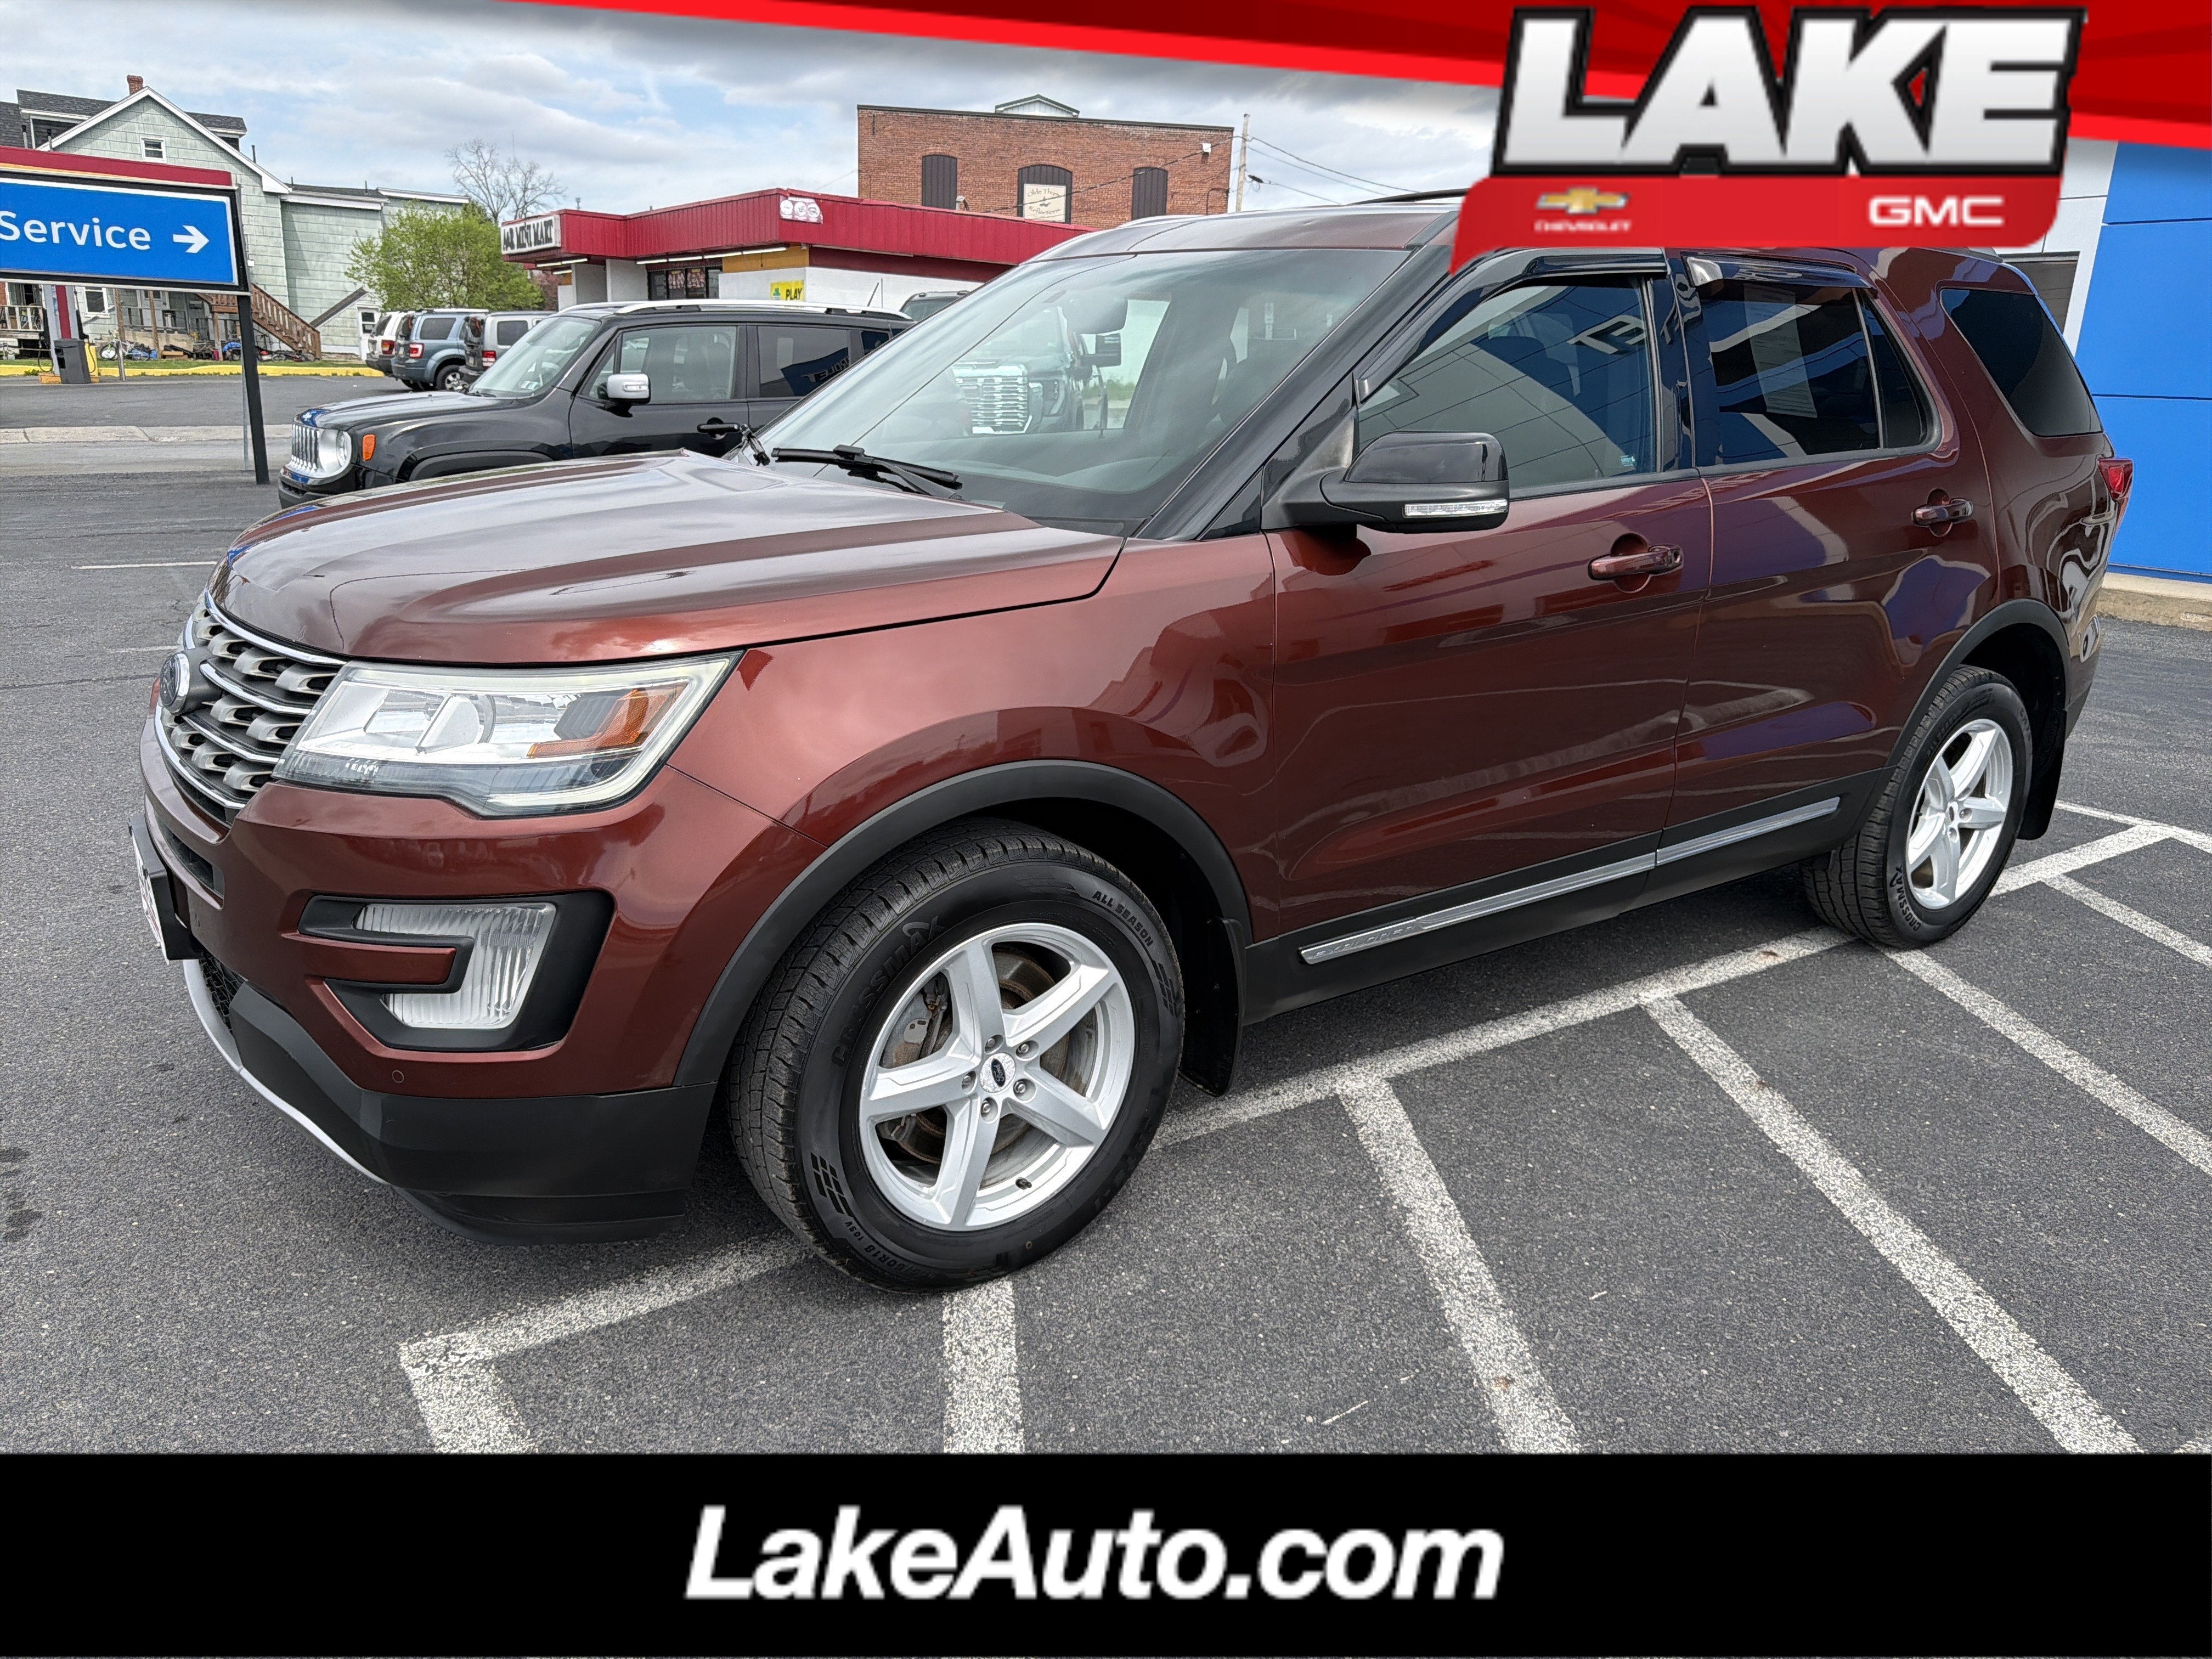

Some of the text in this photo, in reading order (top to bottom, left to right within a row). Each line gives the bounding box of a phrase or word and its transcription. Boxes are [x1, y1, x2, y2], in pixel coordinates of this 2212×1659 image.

[0, 211, 151, 250] Service
[532, 219, 553, 247] MART
[785, 287, 803, 301] PLAY
[1889, 864, 1922, 932] CROSSMAX
[1092, 890, 1114, 908] ALL
[1115, 903, 1154, 947] SEASON
[992, 1063, 1005, 1082] Ford
